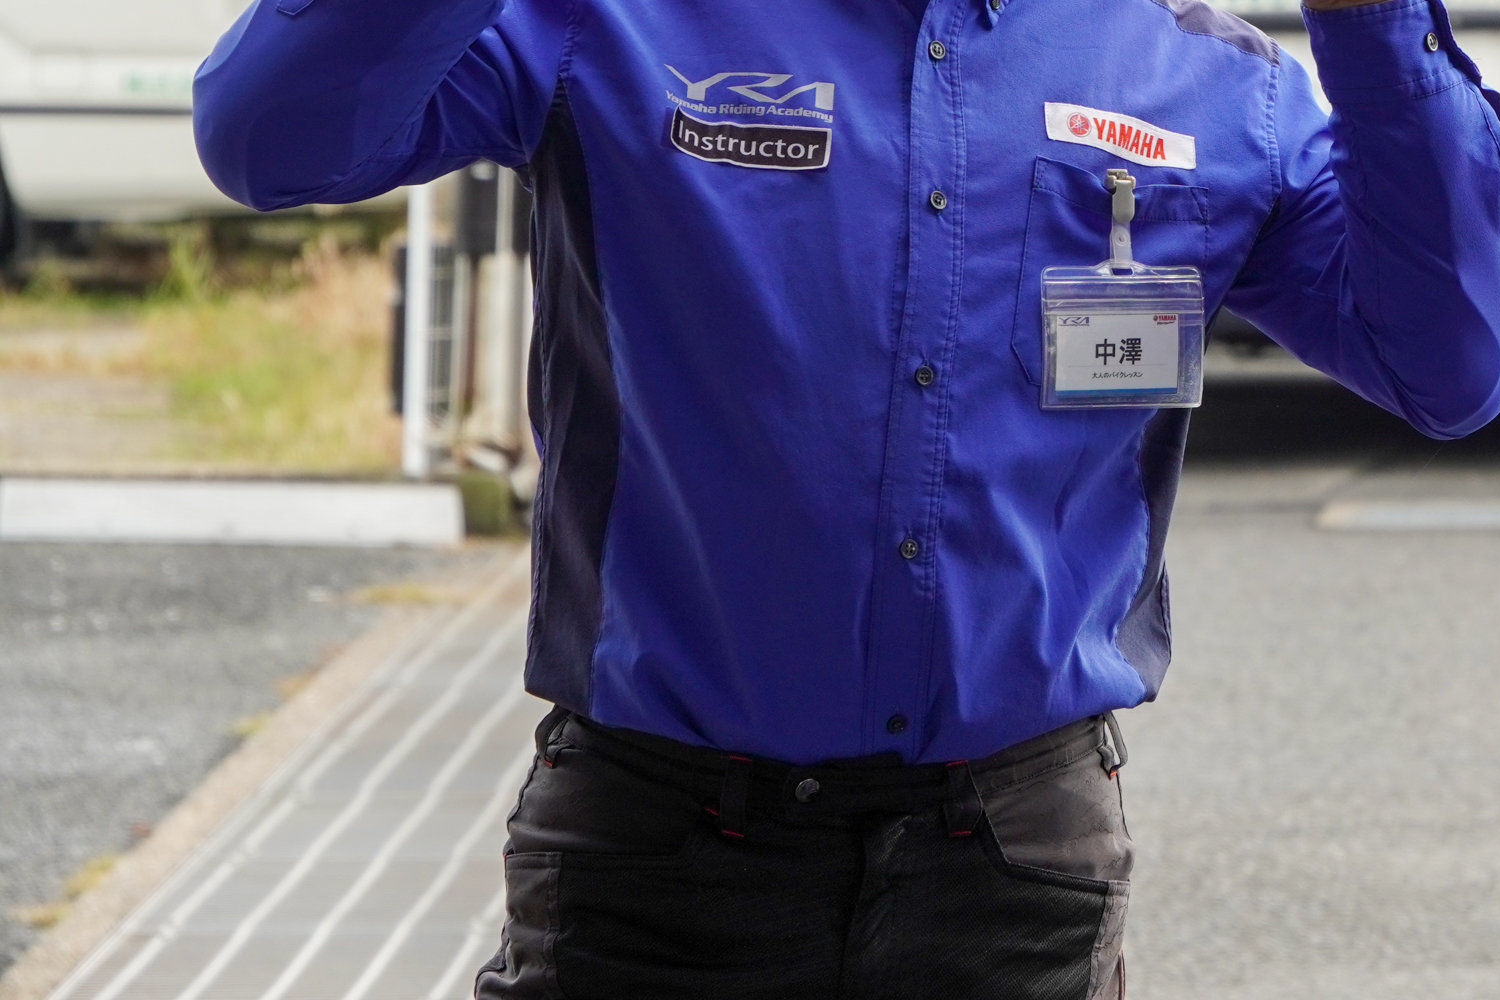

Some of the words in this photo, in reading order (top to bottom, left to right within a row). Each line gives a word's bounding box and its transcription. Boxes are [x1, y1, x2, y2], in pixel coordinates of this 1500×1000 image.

[665, 90, 717, 114] Yamaha
[718, 102, 766, 116] Riding
[766, 105, 833, 123] Academy
[678, 119, 820, 160] Instructor
[1093, 117, 1167, 160] YAMAHA
[1095, 337, 1143, 366] 中澤
